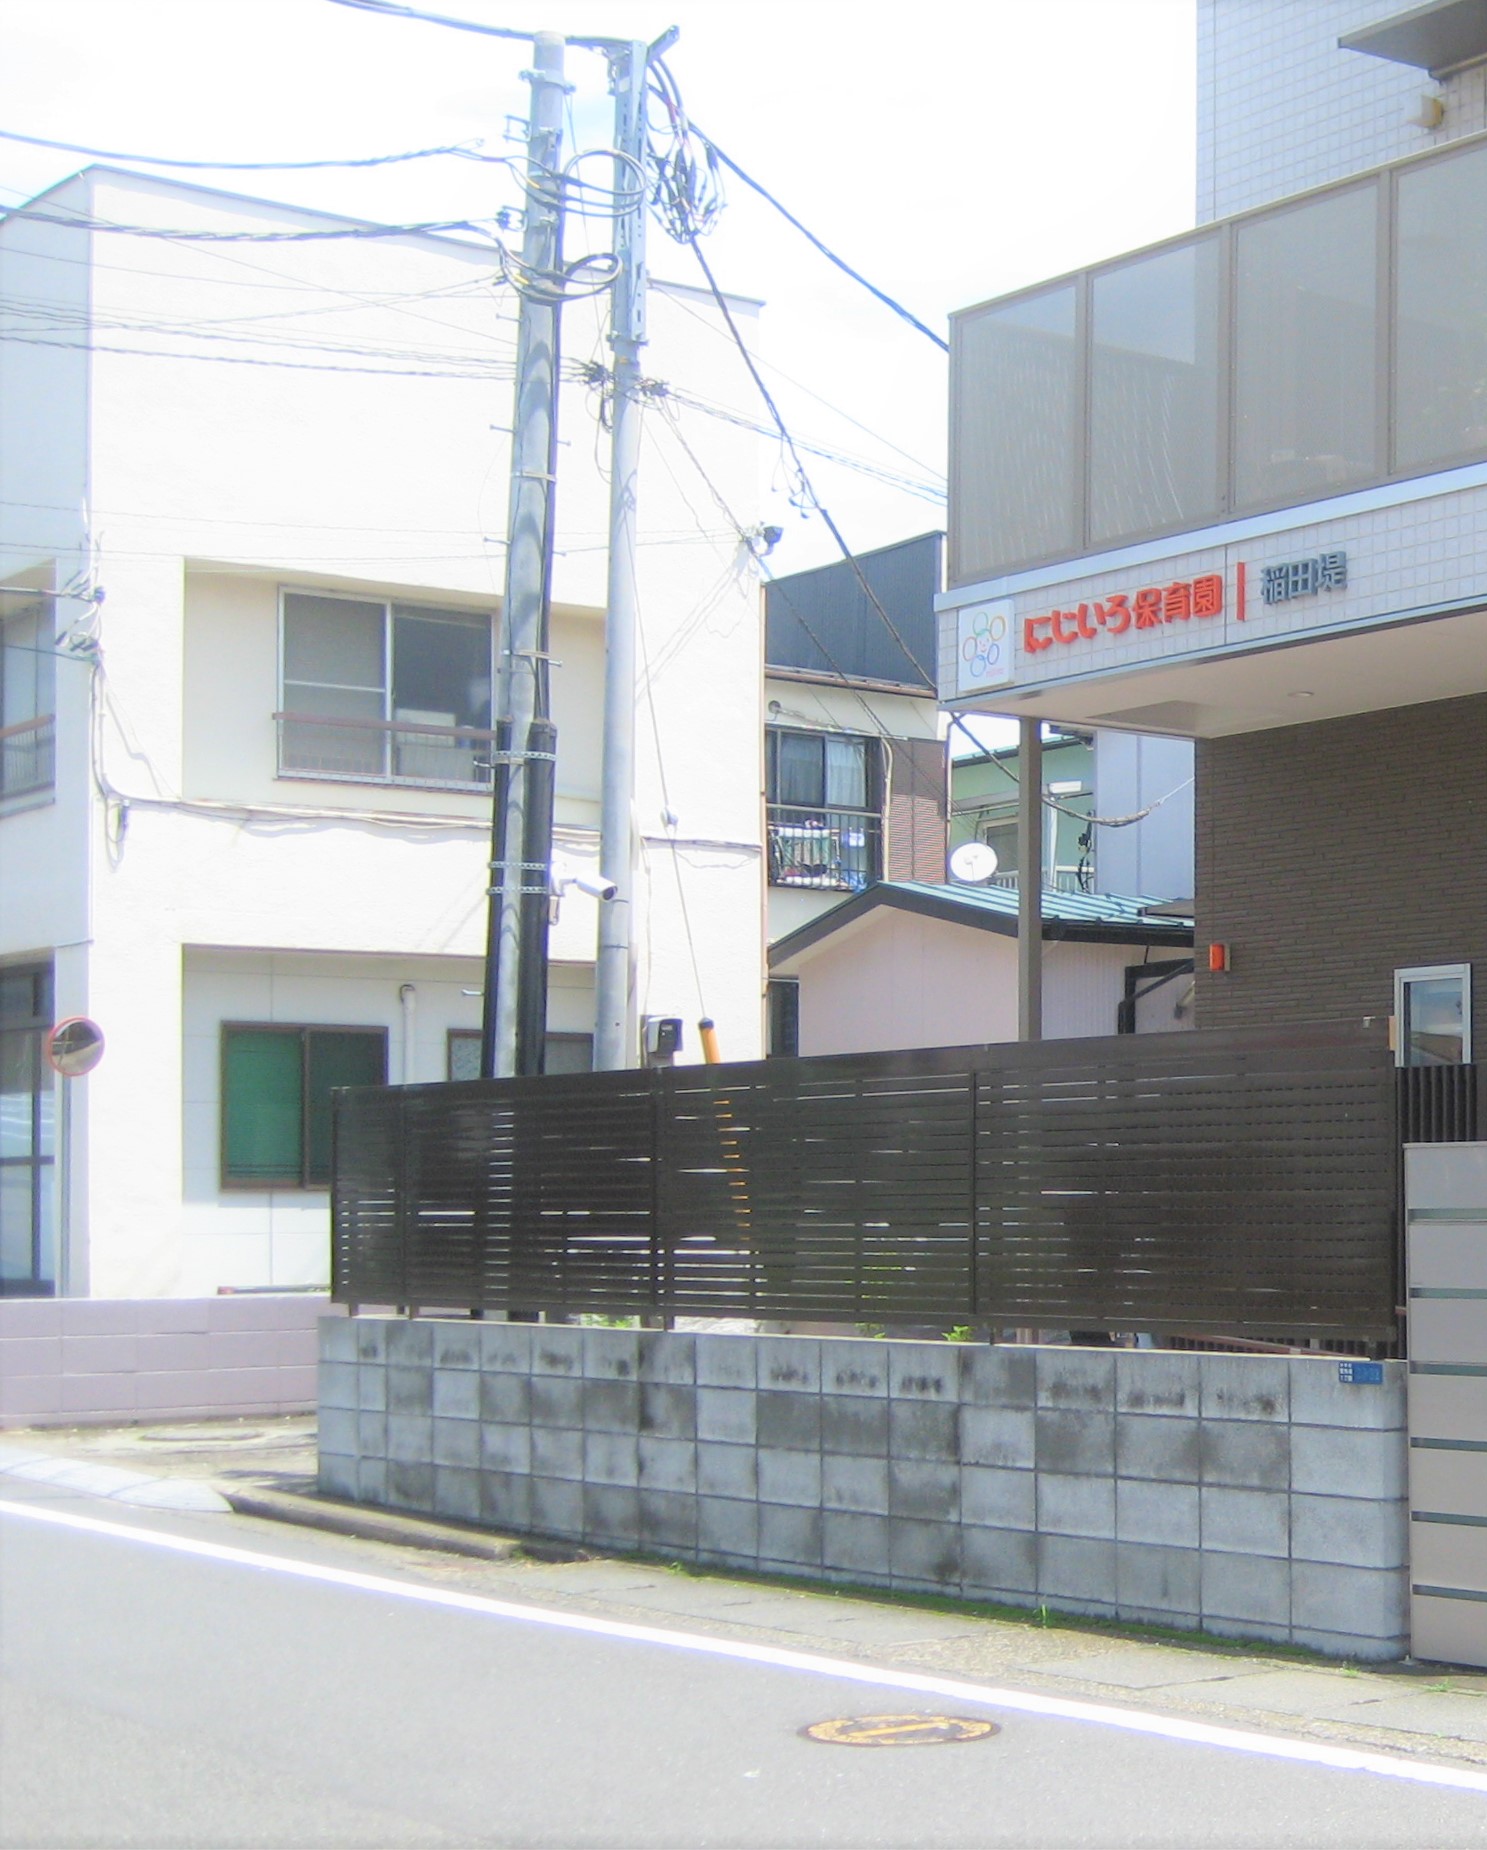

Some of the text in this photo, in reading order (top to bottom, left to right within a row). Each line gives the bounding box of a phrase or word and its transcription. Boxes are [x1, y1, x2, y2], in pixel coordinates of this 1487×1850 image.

[1024, 551, 1347, 653] にじいろ保育園 稲田堤
